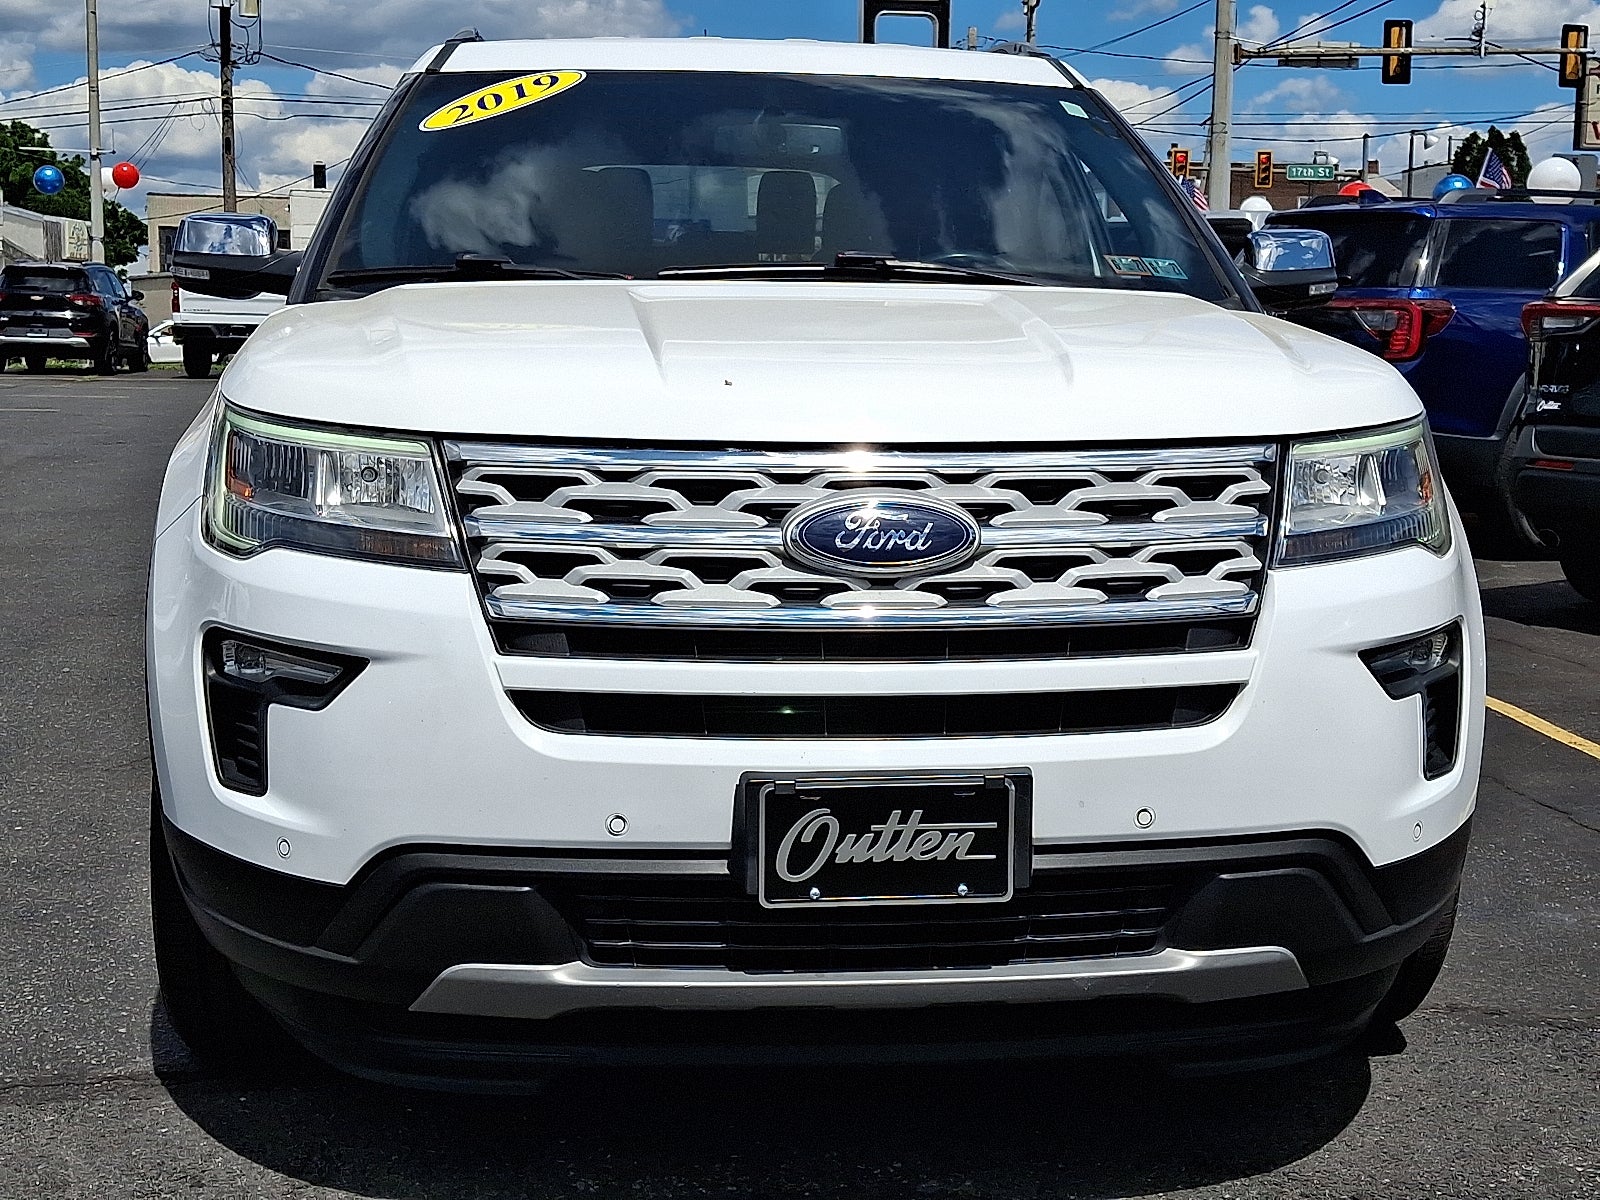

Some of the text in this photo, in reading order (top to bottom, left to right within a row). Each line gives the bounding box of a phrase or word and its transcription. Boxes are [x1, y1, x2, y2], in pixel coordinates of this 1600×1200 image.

[446, 74, 560, 124] 2019
[1291, 167, 1330, 177] 17th St
[834, 507, 934, 551] Ford
[775, 807, 998, 883] Outten
